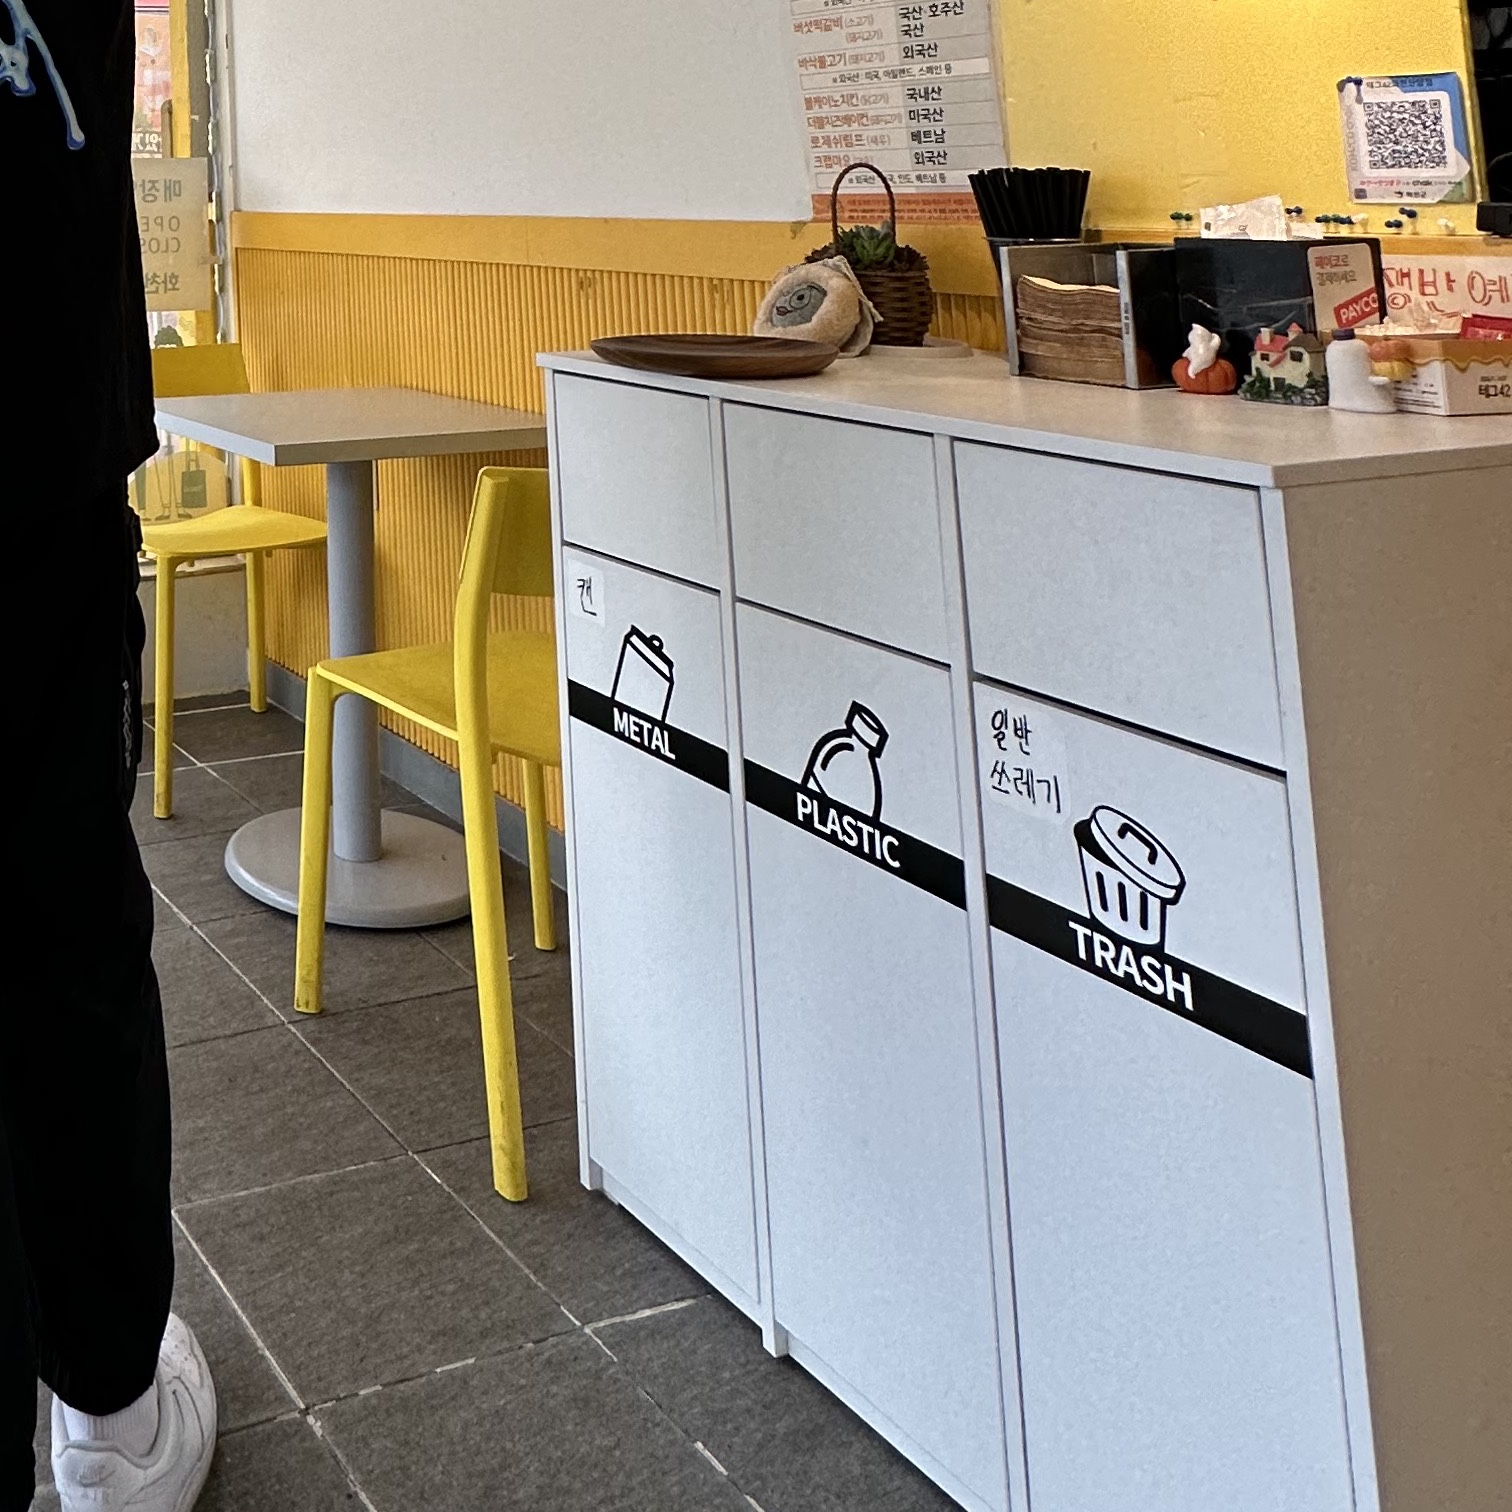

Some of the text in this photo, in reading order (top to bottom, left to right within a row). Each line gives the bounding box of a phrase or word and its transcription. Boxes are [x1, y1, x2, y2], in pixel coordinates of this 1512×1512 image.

[901, 23, 924, 38] 국산
[903, 43, 938, 59] 외국산
[906, 86, 942, 102] 국내산
[908, 107, 944, 123] 미국산
[911, 128, 946, 144] 베트남
[914, 150, 947, 166] 외국산
[1340, 292, 1378, 323] PAYCO
[576, 577, 599, 617] 캔
[613, 706, 676, 760] METAL
[991, 708, 1033, 751] 일반
[991, 766, 1063, 813] 쓰레기
[796, 792, 901, 870] PLASTIC
[1068, 921, 1194, 1012] TRASH
